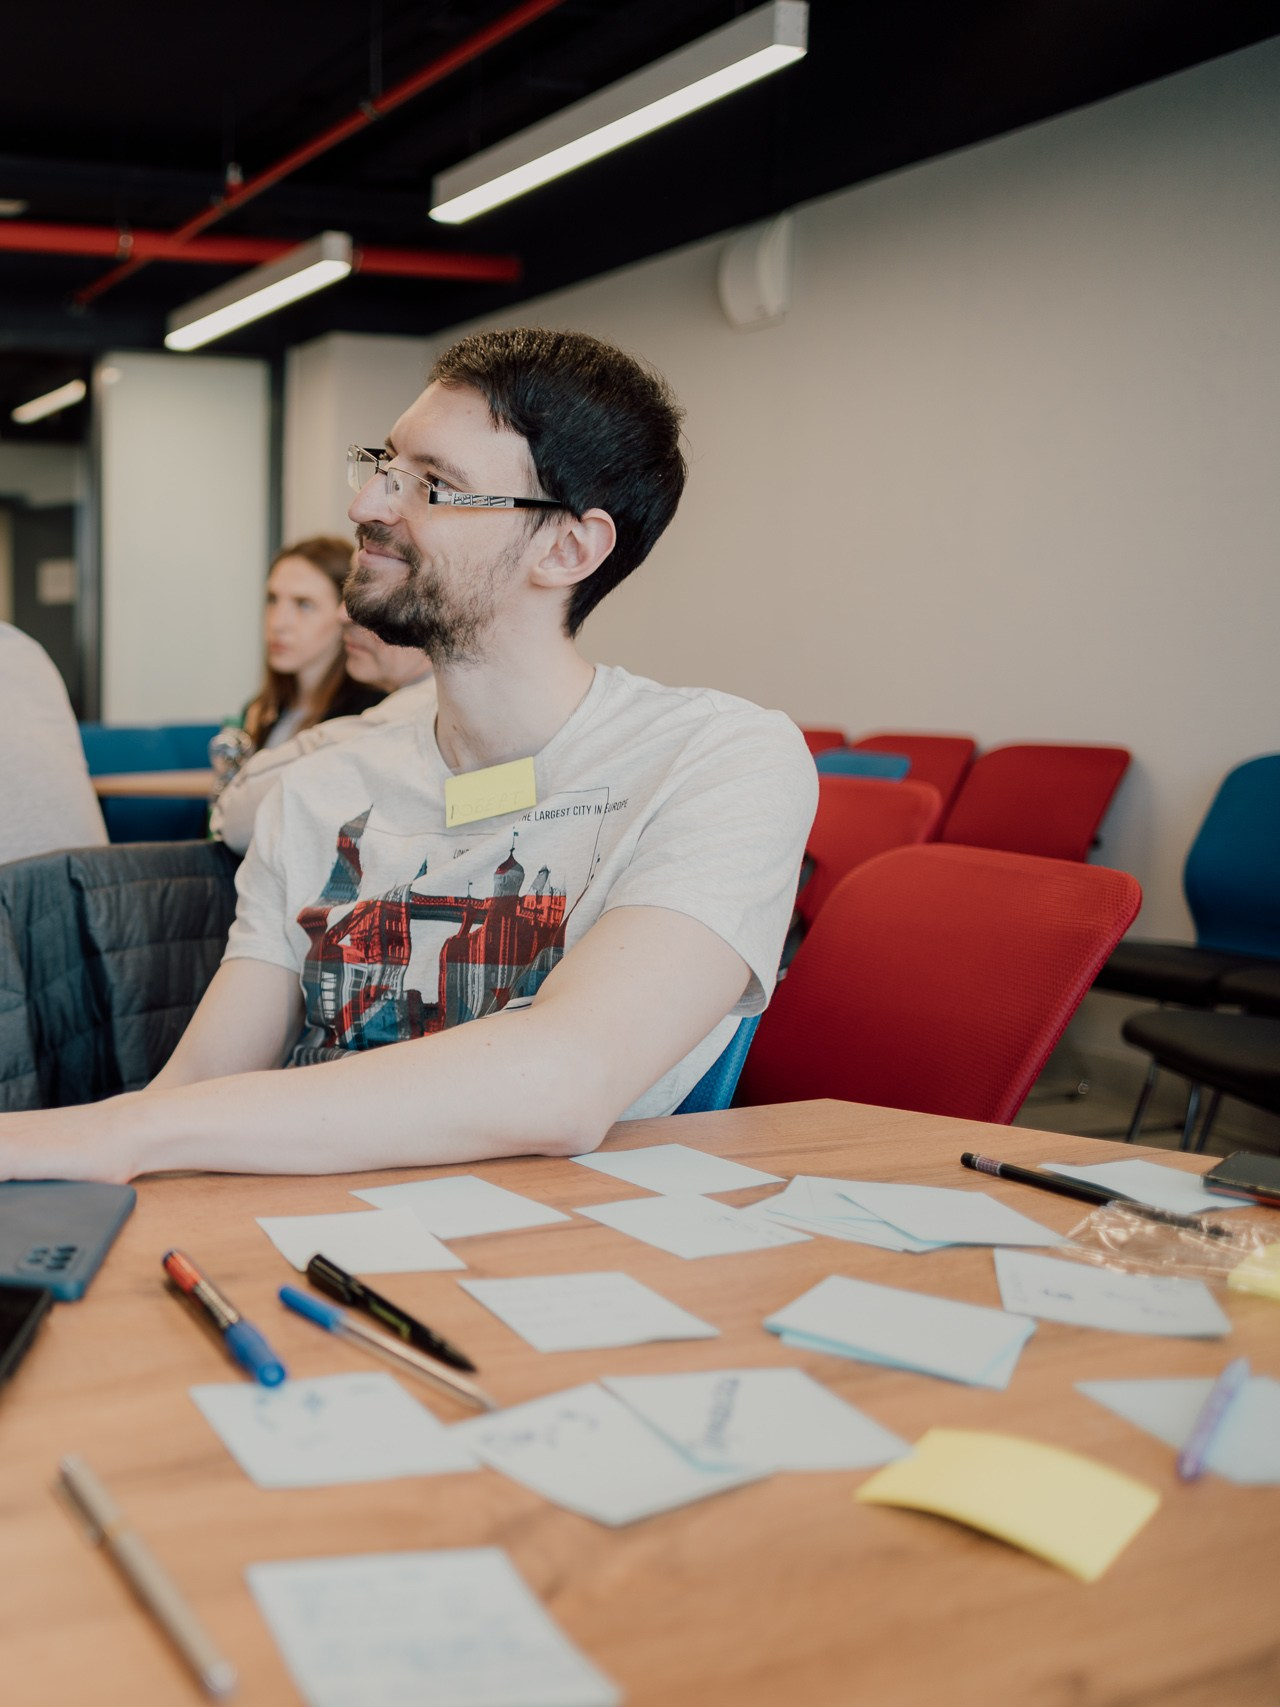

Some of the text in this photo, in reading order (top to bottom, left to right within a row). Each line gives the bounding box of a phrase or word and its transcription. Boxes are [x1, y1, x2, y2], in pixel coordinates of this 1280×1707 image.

[534, 808, 570, 821] LARGEST
[573, 805, 591, 816] CITY
[594, 804, 602, 815] IN
[604, 798, 629, 814] EUROPE
